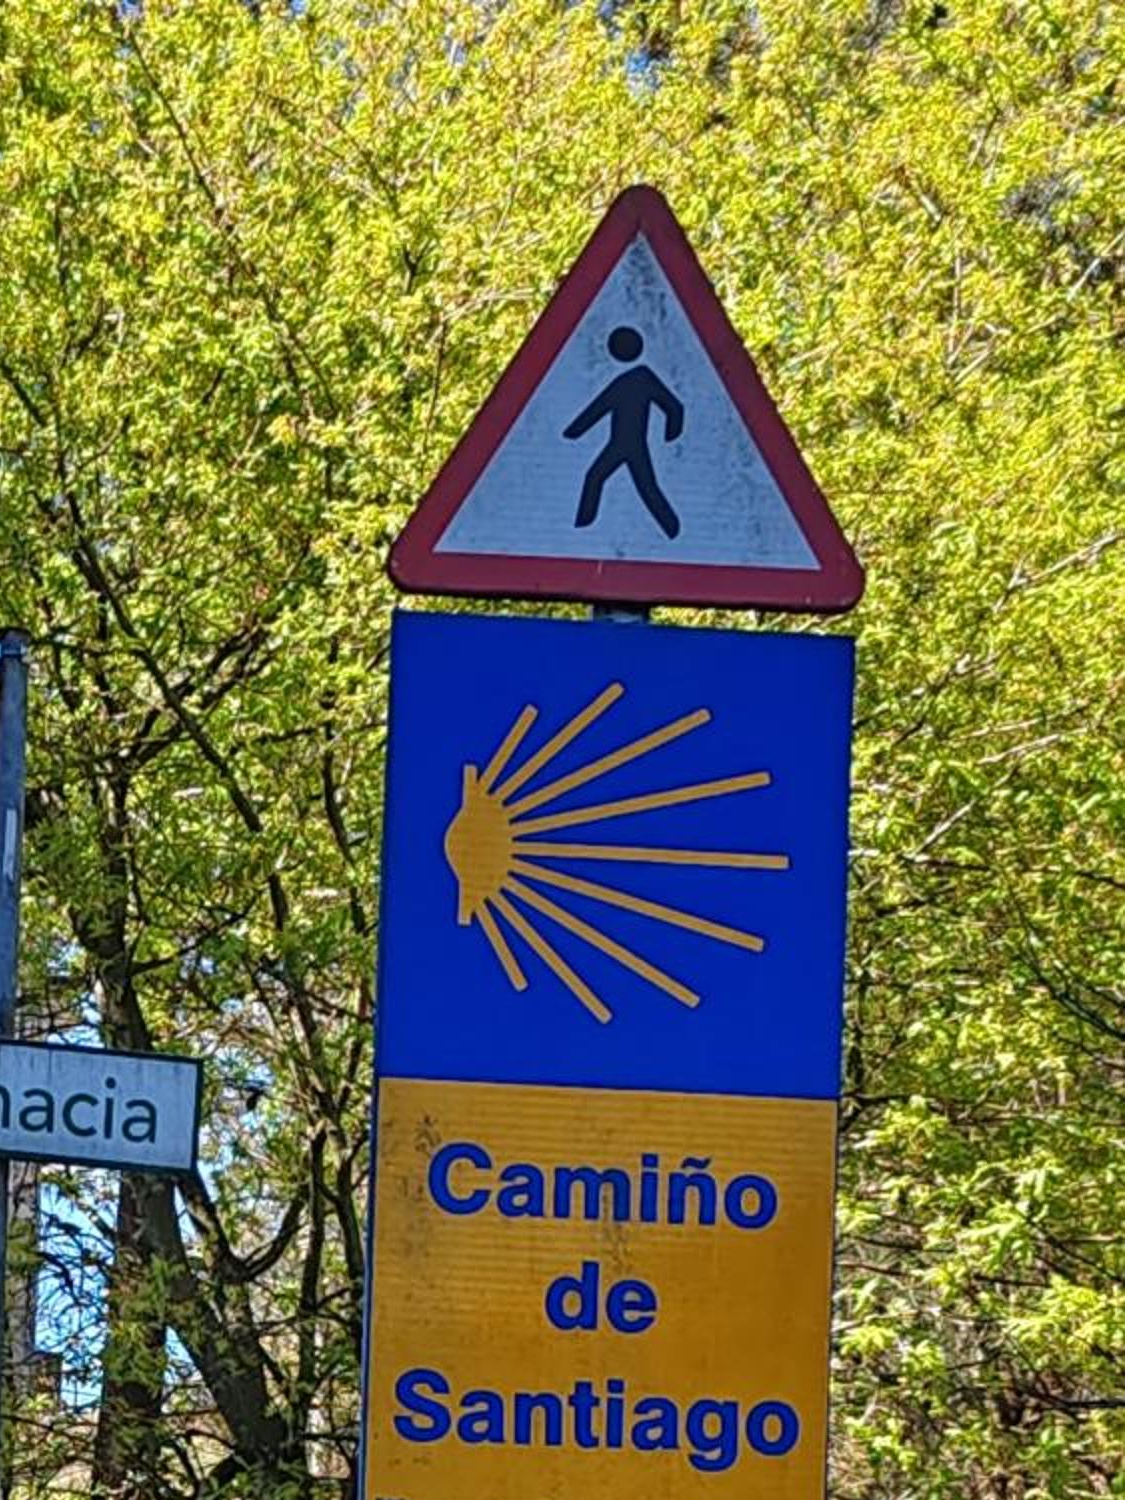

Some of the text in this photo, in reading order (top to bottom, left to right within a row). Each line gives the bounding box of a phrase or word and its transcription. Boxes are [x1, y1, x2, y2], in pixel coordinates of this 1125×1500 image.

[428, 1141, 779, 1230] Camiño
[545, 1260, 659, 1334] de
[393, 1368, 802, 1472] Santiago
